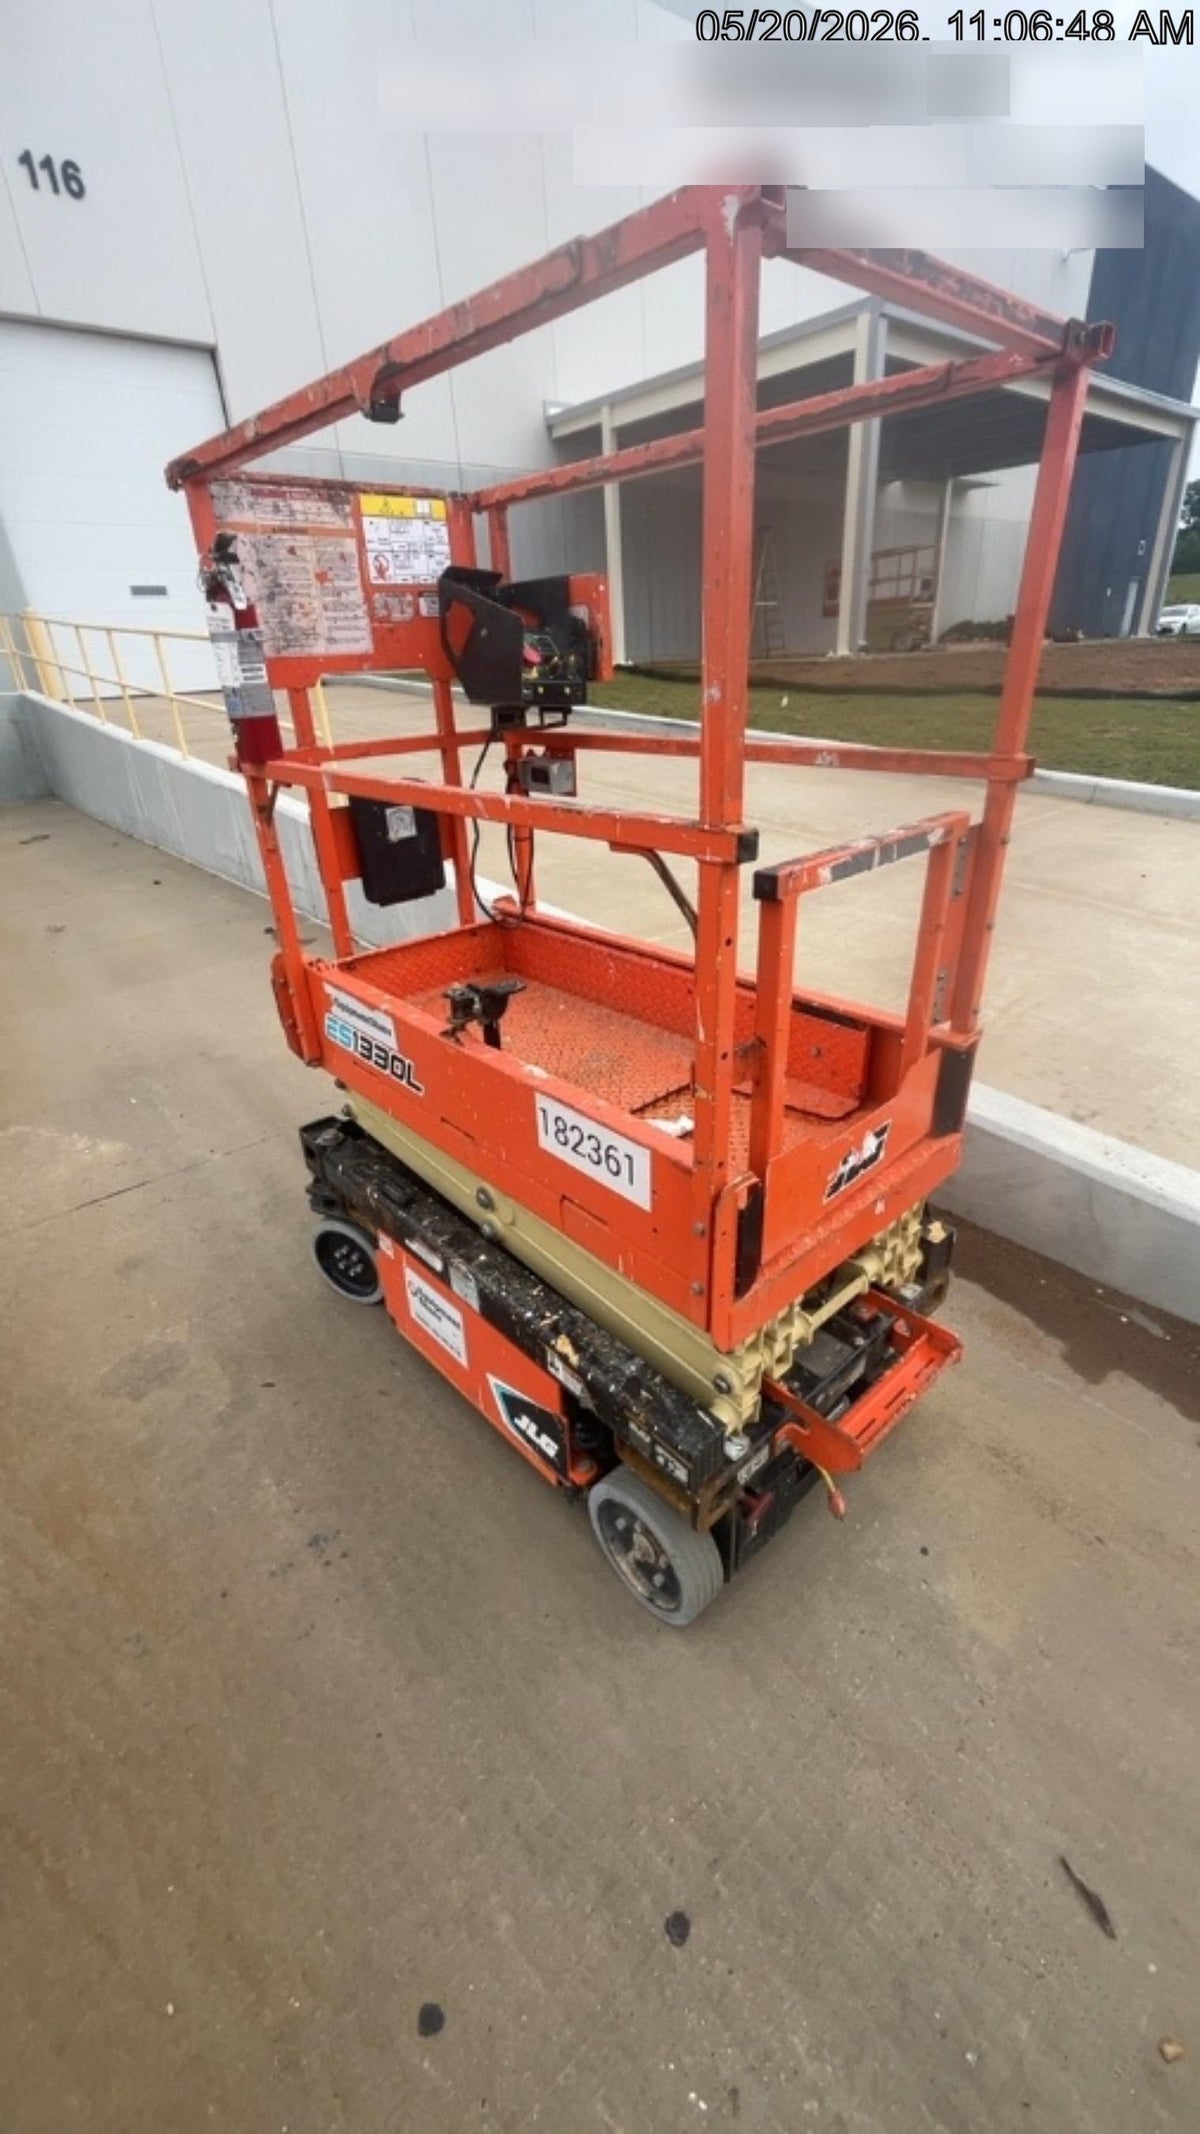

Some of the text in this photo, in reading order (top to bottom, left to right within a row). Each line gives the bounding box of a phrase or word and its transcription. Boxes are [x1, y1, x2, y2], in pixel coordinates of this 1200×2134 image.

[18, 149, 85, 200] 116
[326, 1015, 422, 1092] ES1330L
[540, 1106, 634, 1186] 182361
[514, 1415, 559, 1459] JLG
